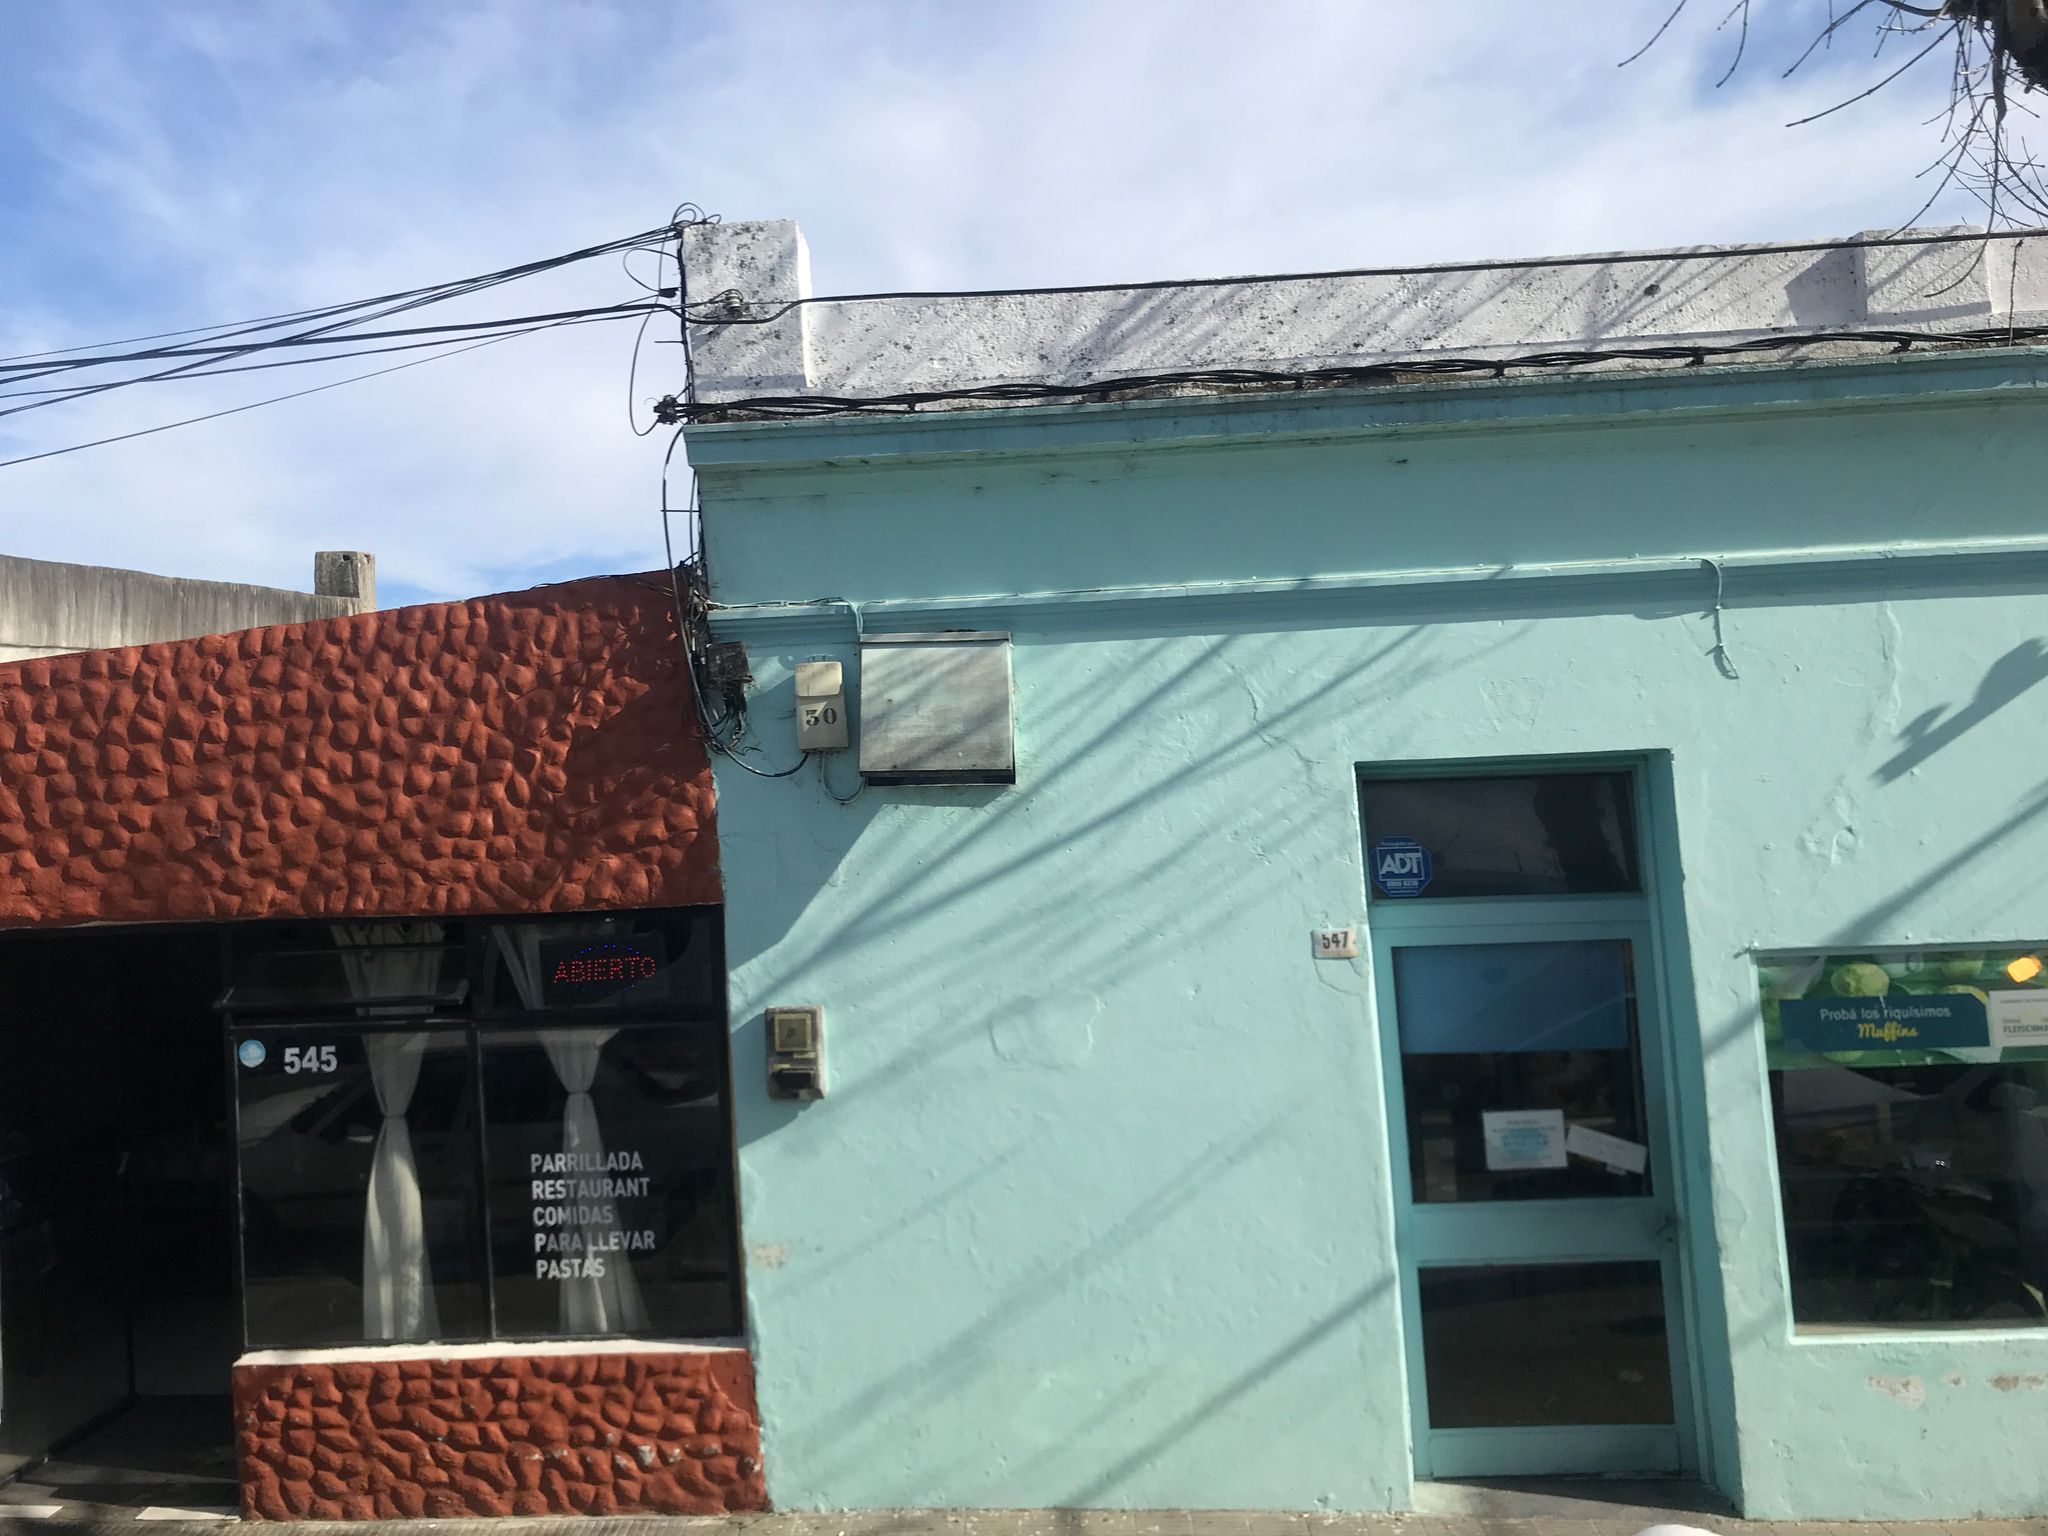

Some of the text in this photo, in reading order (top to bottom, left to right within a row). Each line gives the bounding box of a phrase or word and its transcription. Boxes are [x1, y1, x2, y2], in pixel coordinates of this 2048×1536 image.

[1380, 852, 1422, 874] ADT
[1321, 931, 1349, 949] 547
[553, 956, 656, 983] ABIERTO
[1819, 1006, 1952, 1021] Probá los riquísimos
[1856, 1020, 1919, 1042] Muffins
[284, 1045, 338, 1074] 545
[530, 1151, 644, 1173] PARRILLADA
[531, 1177, 651, 1200] RESTAURANT
[532, 1205, 614, 1227] COMIDAS
[534, 1230, 656, 1253] PARA LLEVAR
[535, 1258, 606, 1280] PASTAS
